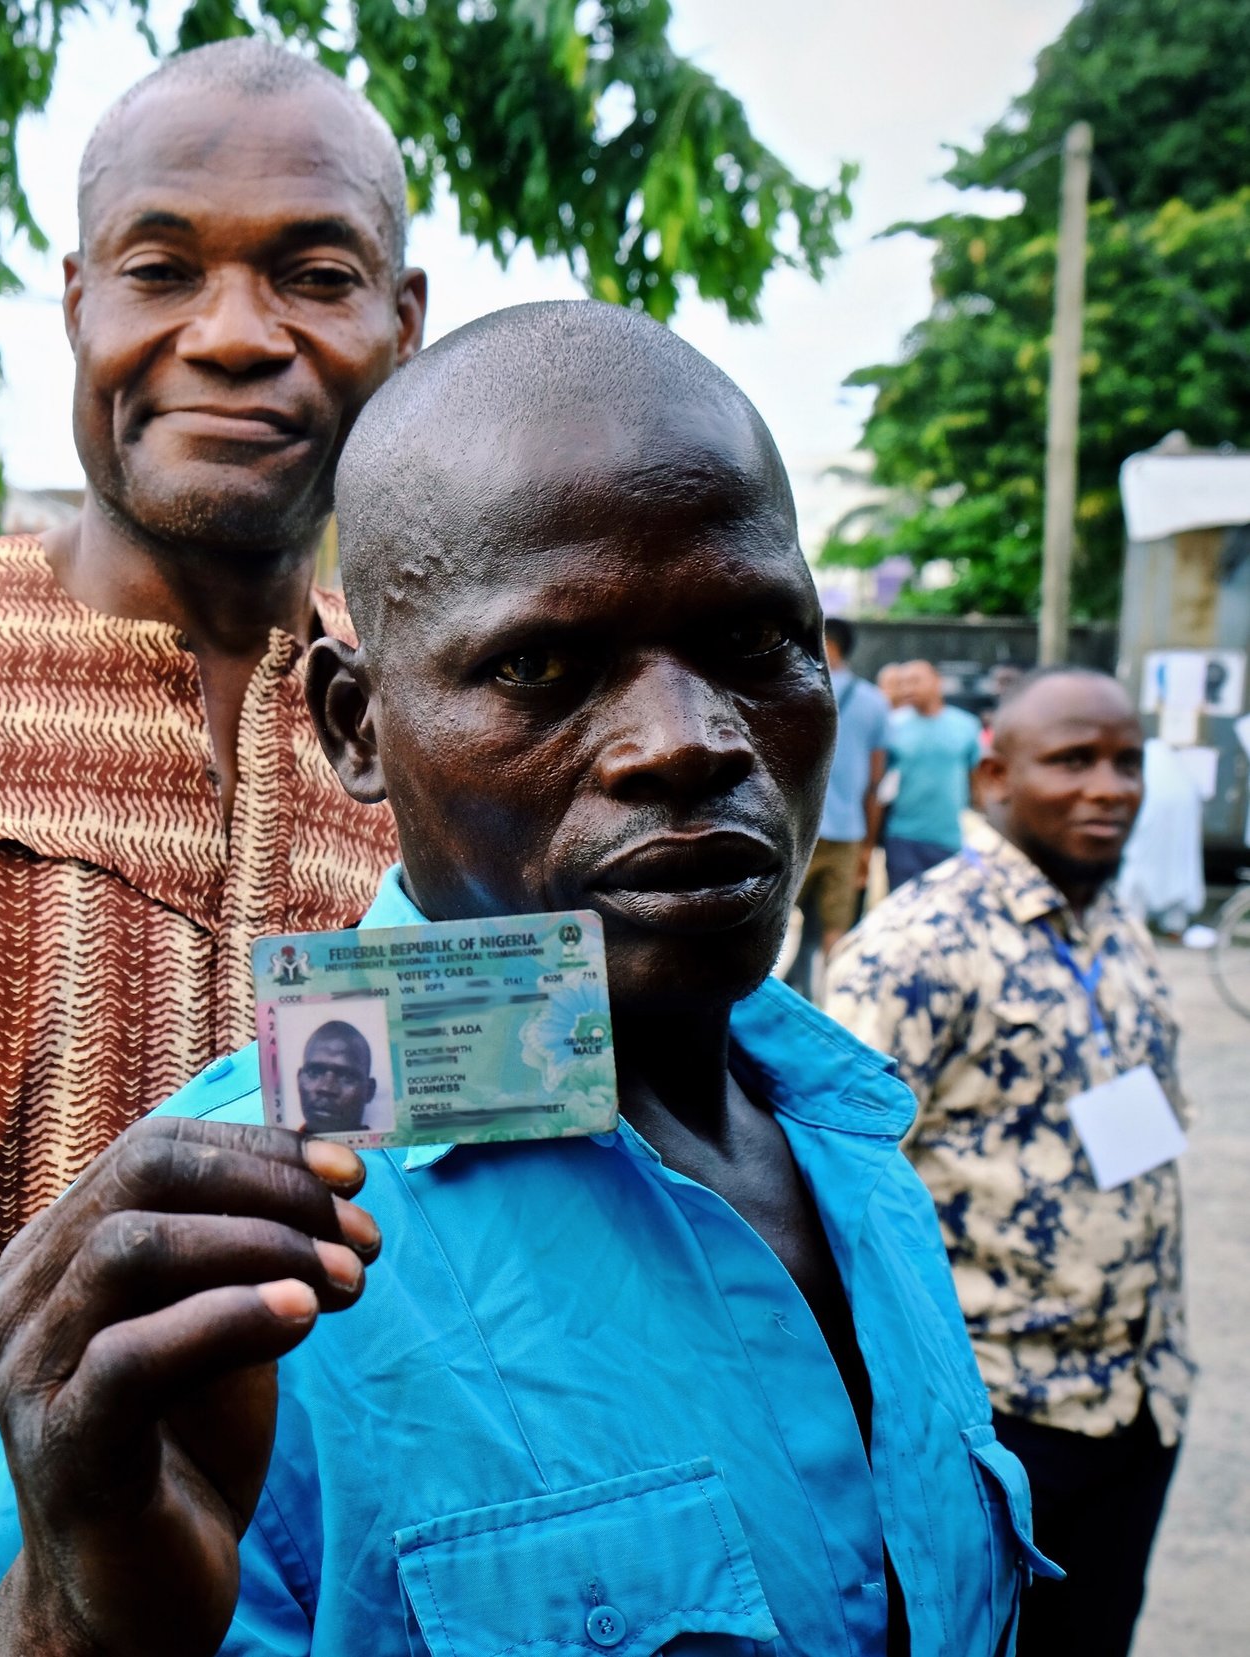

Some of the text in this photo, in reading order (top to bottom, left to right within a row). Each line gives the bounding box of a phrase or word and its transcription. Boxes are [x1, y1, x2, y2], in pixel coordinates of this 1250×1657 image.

[329, 933, 537, 961] FEDERAL REPUBLIC OF NIGERIA
[396, 966, 474, 981] VOTER'S CARD
[452, 1024, 483, 1036] SADA
[573, 1045, 602, 1056] MALE
[408, 1083, 460, 1096] BUSINESS
